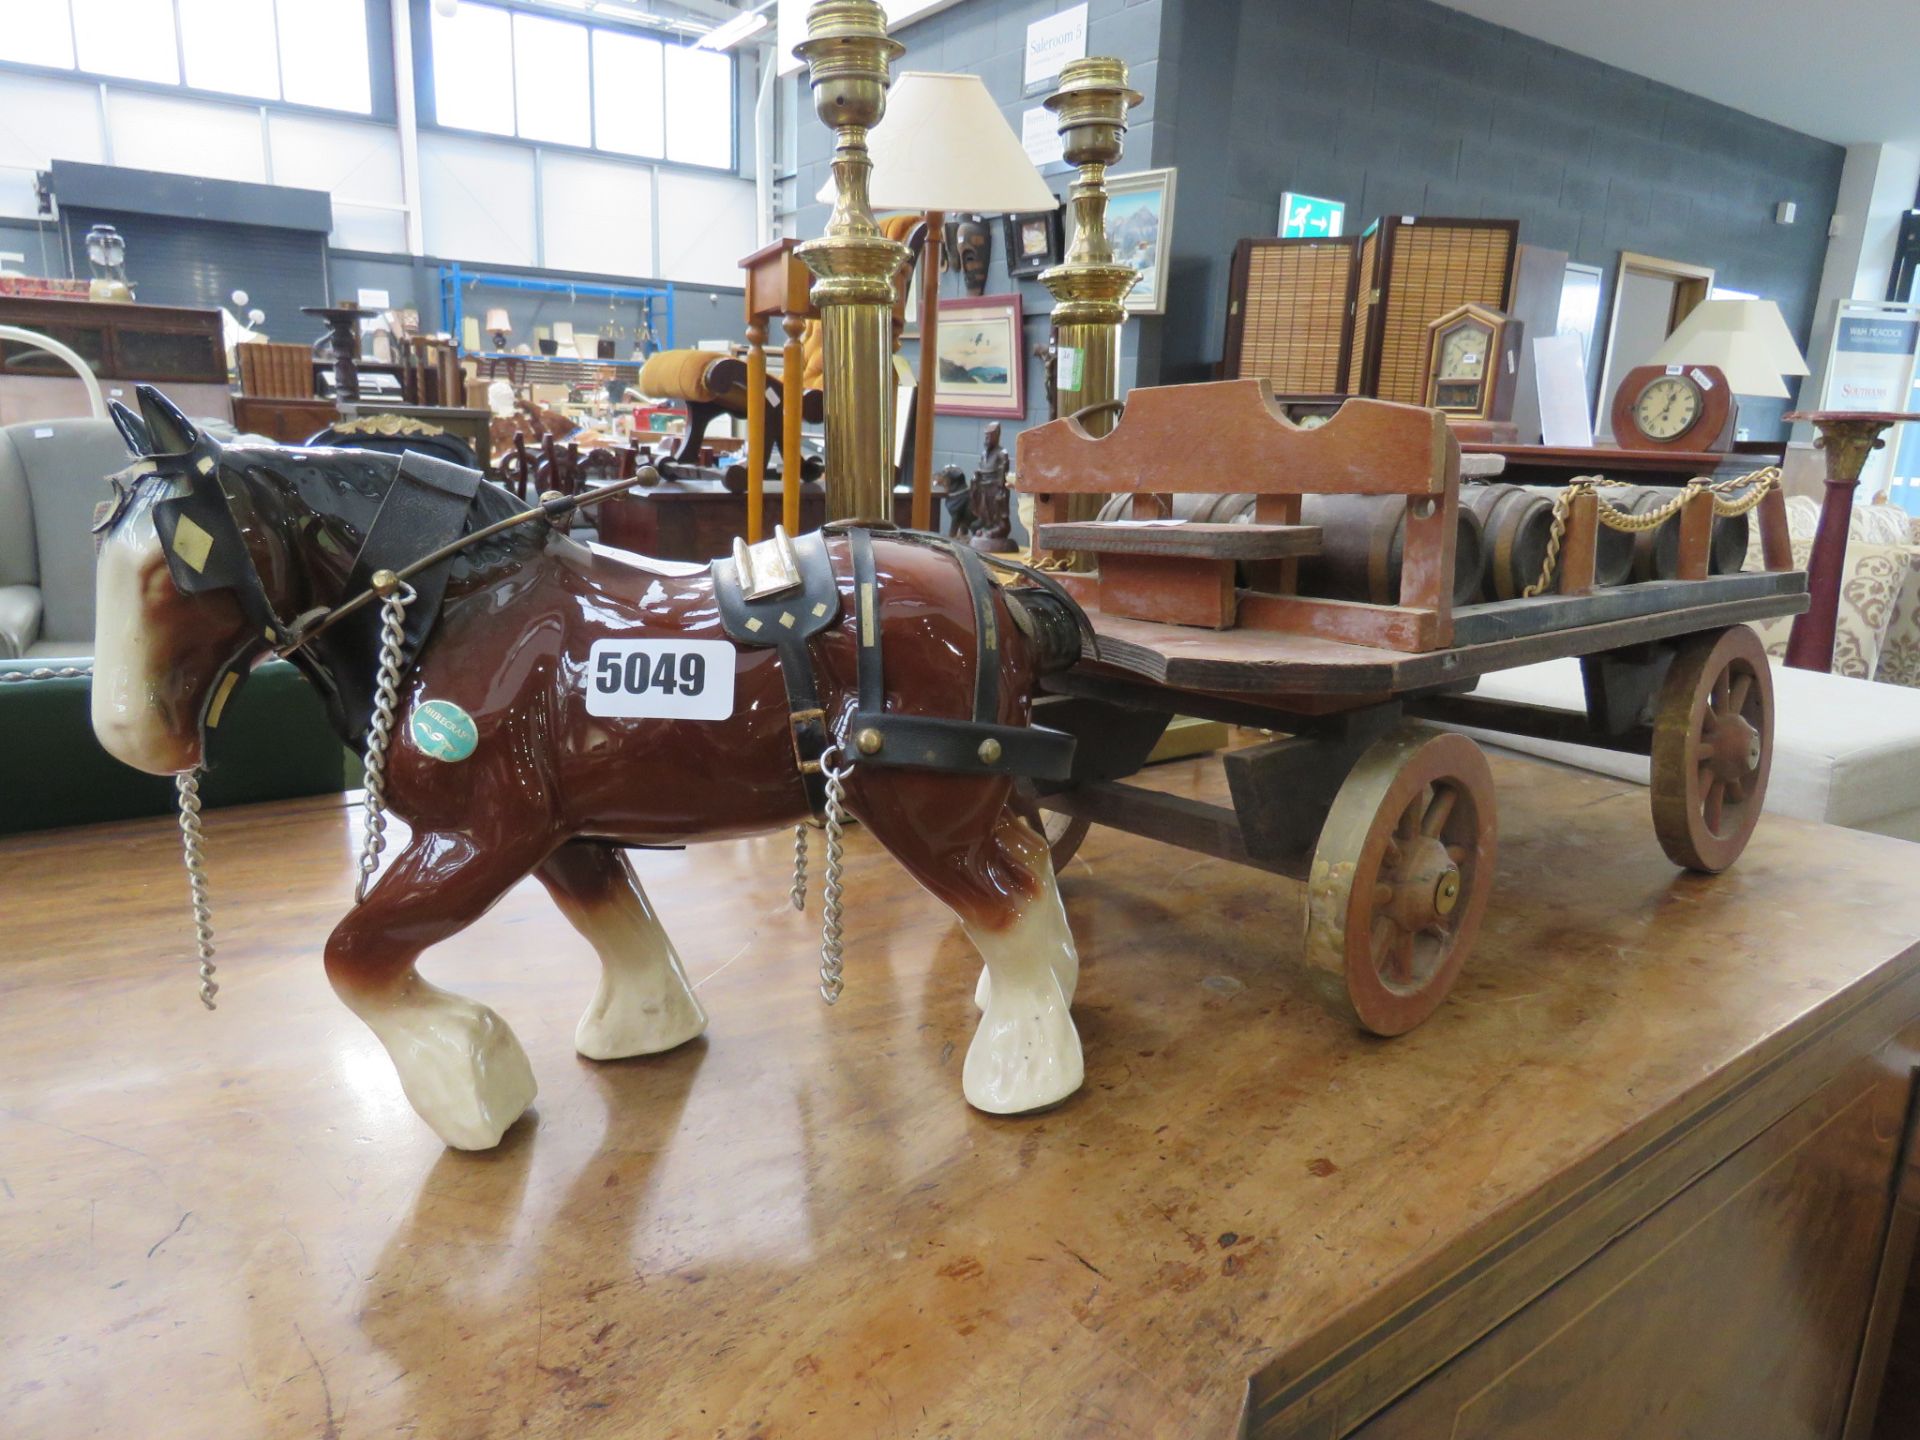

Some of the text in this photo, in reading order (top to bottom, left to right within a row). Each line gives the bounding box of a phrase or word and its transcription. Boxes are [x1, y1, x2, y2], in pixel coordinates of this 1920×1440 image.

[1030, 24, 1082, 54] Saleroom 5
[1868, 327, 1903, 338] PEACOCK
[596, 652, 705, 696] 5049
